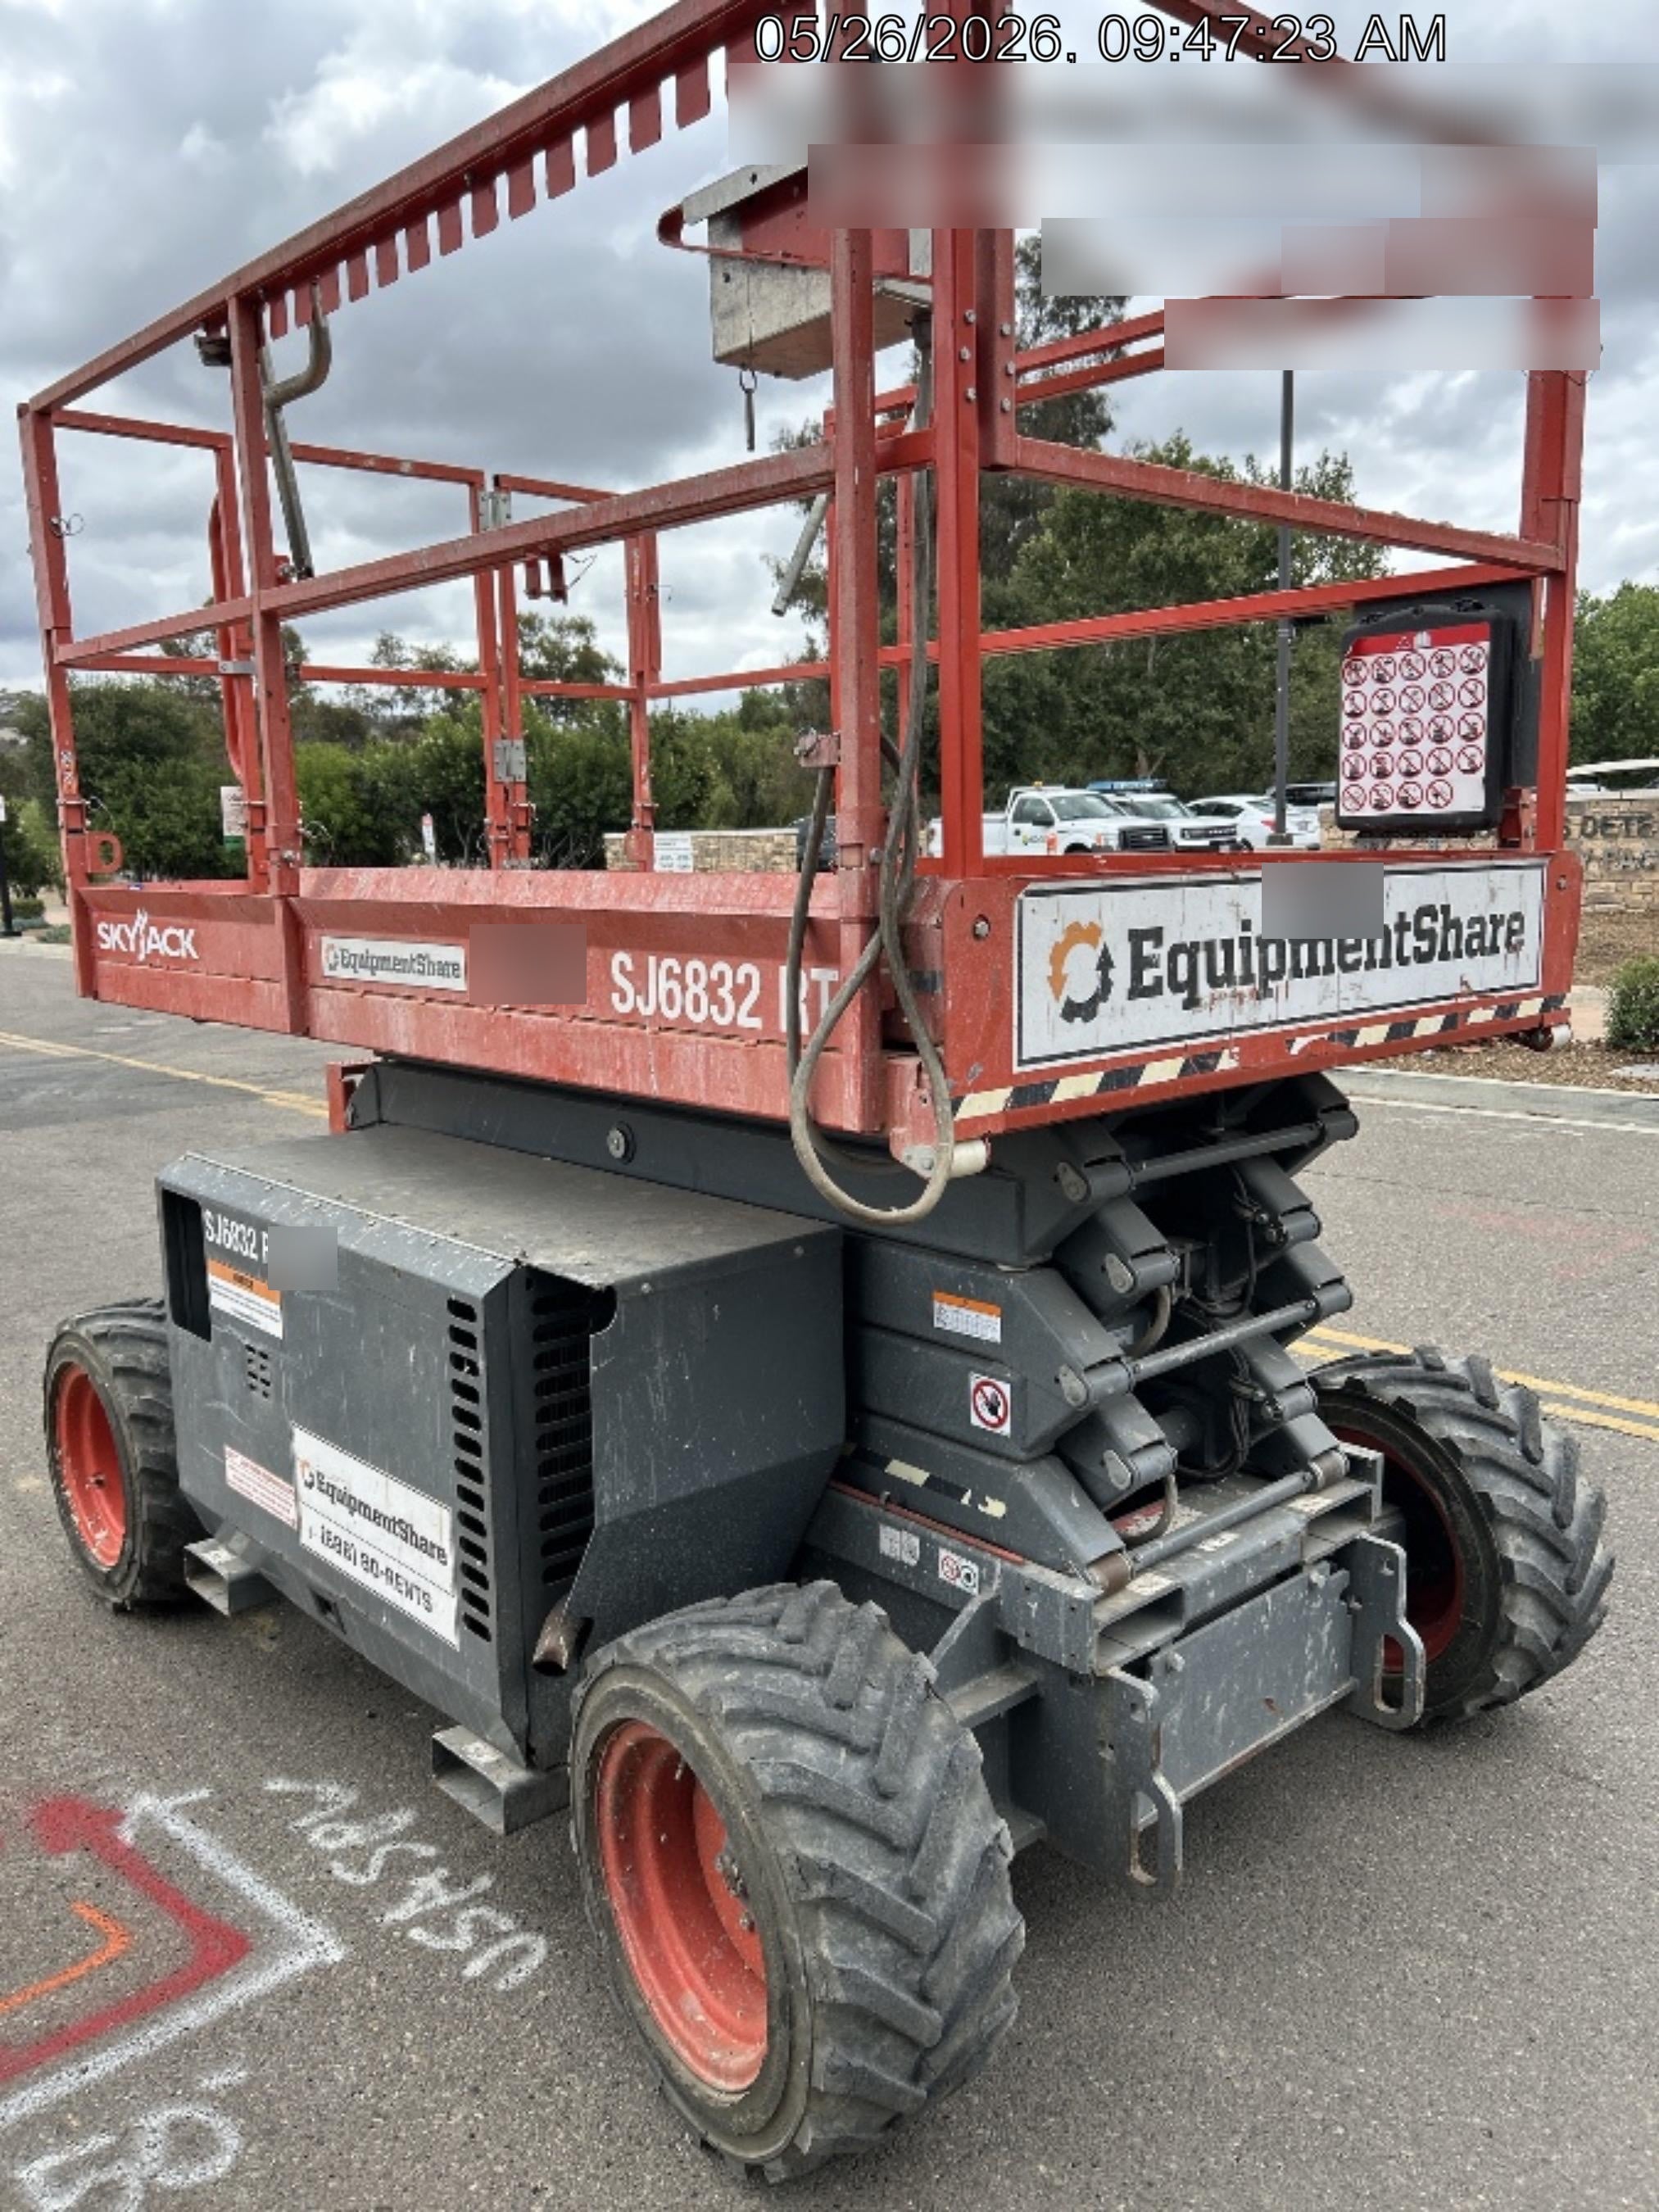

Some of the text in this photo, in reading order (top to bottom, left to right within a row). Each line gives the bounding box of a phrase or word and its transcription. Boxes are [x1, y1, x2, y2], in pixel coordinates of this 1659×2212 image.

[97, 909, 199, 961] SKYJACK
[340, 947, 460, 979] EquipmentShare
[1127, 904, 1525, 1011] EquipmentShare
[610, 950, 763, 1030] SJ6832
